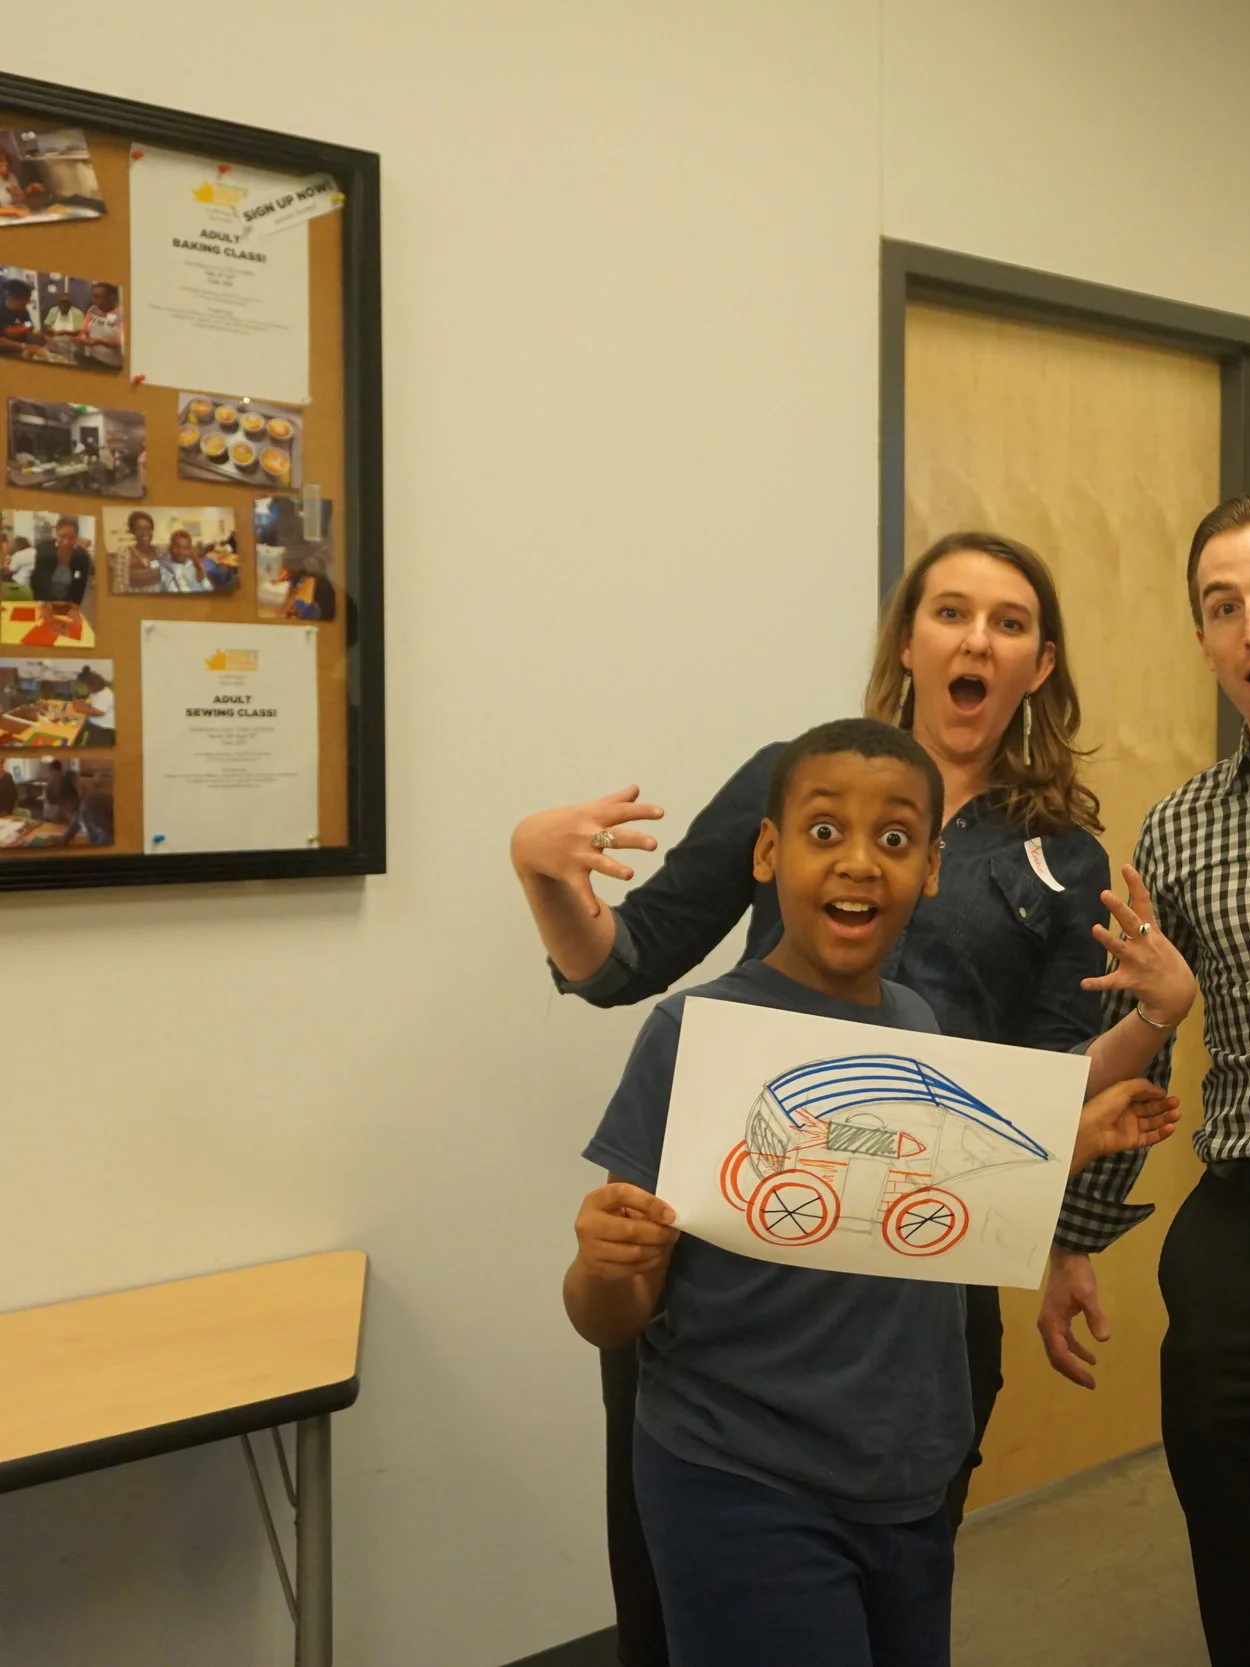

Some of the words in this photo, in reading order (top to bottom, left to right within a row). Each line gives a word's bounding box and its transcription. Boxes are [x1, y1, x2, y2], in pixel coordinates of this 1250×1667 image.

[243, 202, 276, 222] SIGN
[275, 195, 294, 210] UP
[200, 229, 240, 244] ADULT
[172, 238, 221, 255] BAKING
[223, 247, 267, 263] CLASS!
[213, 695, 252, 704] ADULT
[185, 708, 234, 717] SEWING
[236, 708, 277, 717] CLASS!
